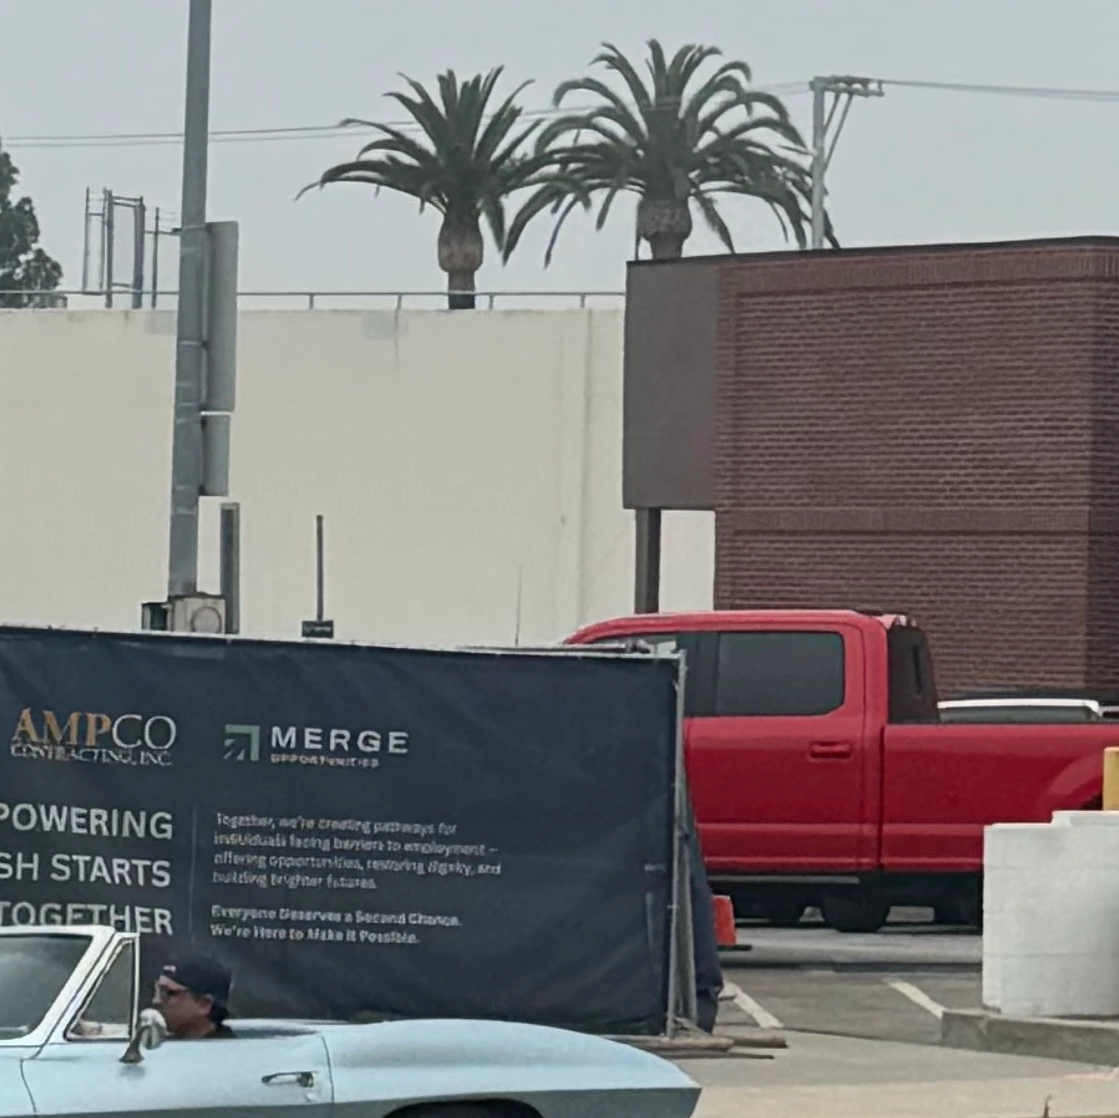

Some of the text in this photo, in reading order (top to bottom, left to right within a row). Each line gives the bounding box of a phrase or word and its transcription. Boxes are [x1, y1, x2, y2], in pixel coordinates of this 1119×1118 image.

[12, 707, 177, 750] AMPCO
[271, 725, 409, 754] MERGE
[289, 833, 331, 852] facing
[50, 854, 171, 888] STARTS
[211, 904, 277, 922] Everyone
[210, 923, 252, 938] We're
[253, 925, 287, 939] Here
[289, 928, 305, 940] to
[307, 928, 344, 941] Make
